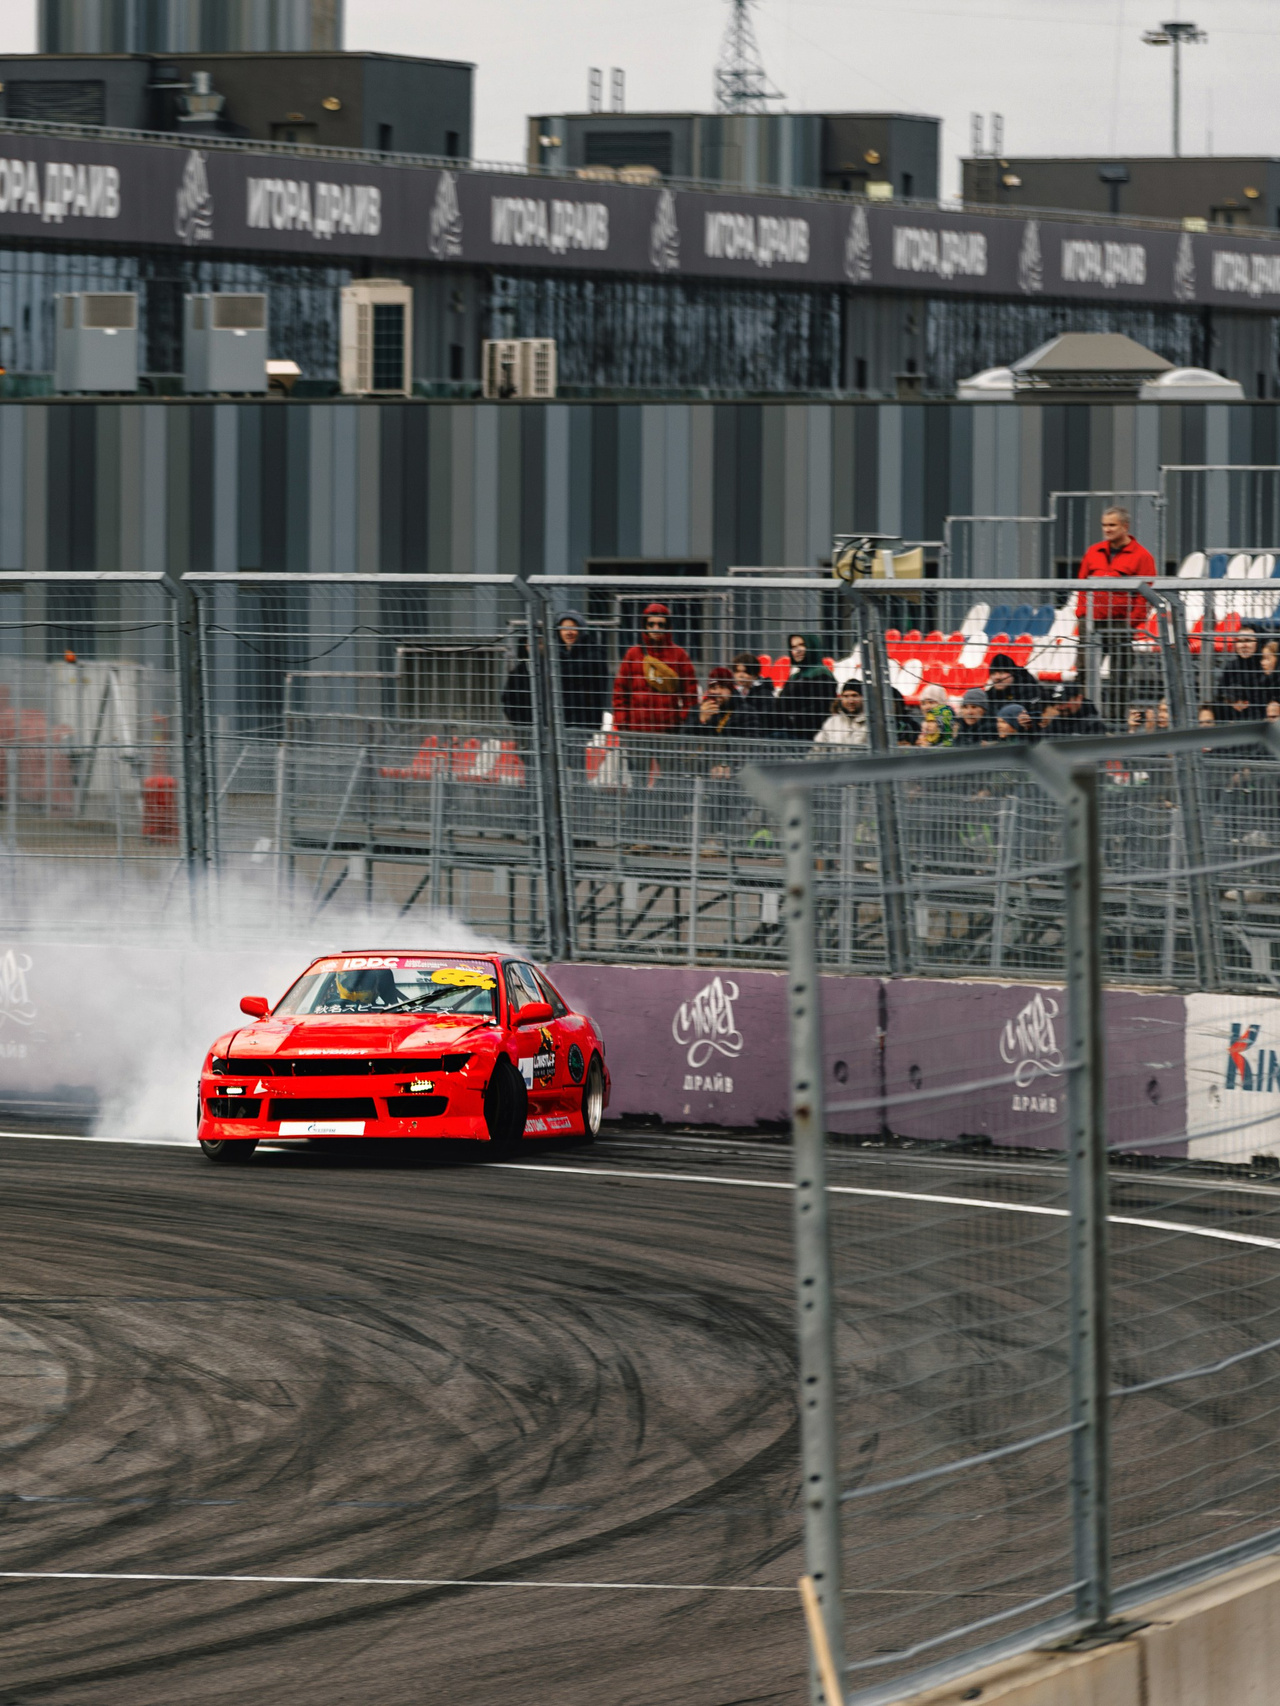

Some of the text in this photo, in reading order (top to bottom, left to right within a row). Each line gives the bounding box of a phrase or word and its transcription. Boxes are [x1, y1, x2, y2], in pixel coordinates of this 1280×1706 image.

[343, 957, 400, 968] IDDC
[683, 1072, 734, 1093] ДРАЙВ
[1011, 1093, 1058, 1114] ДРАЙВ
